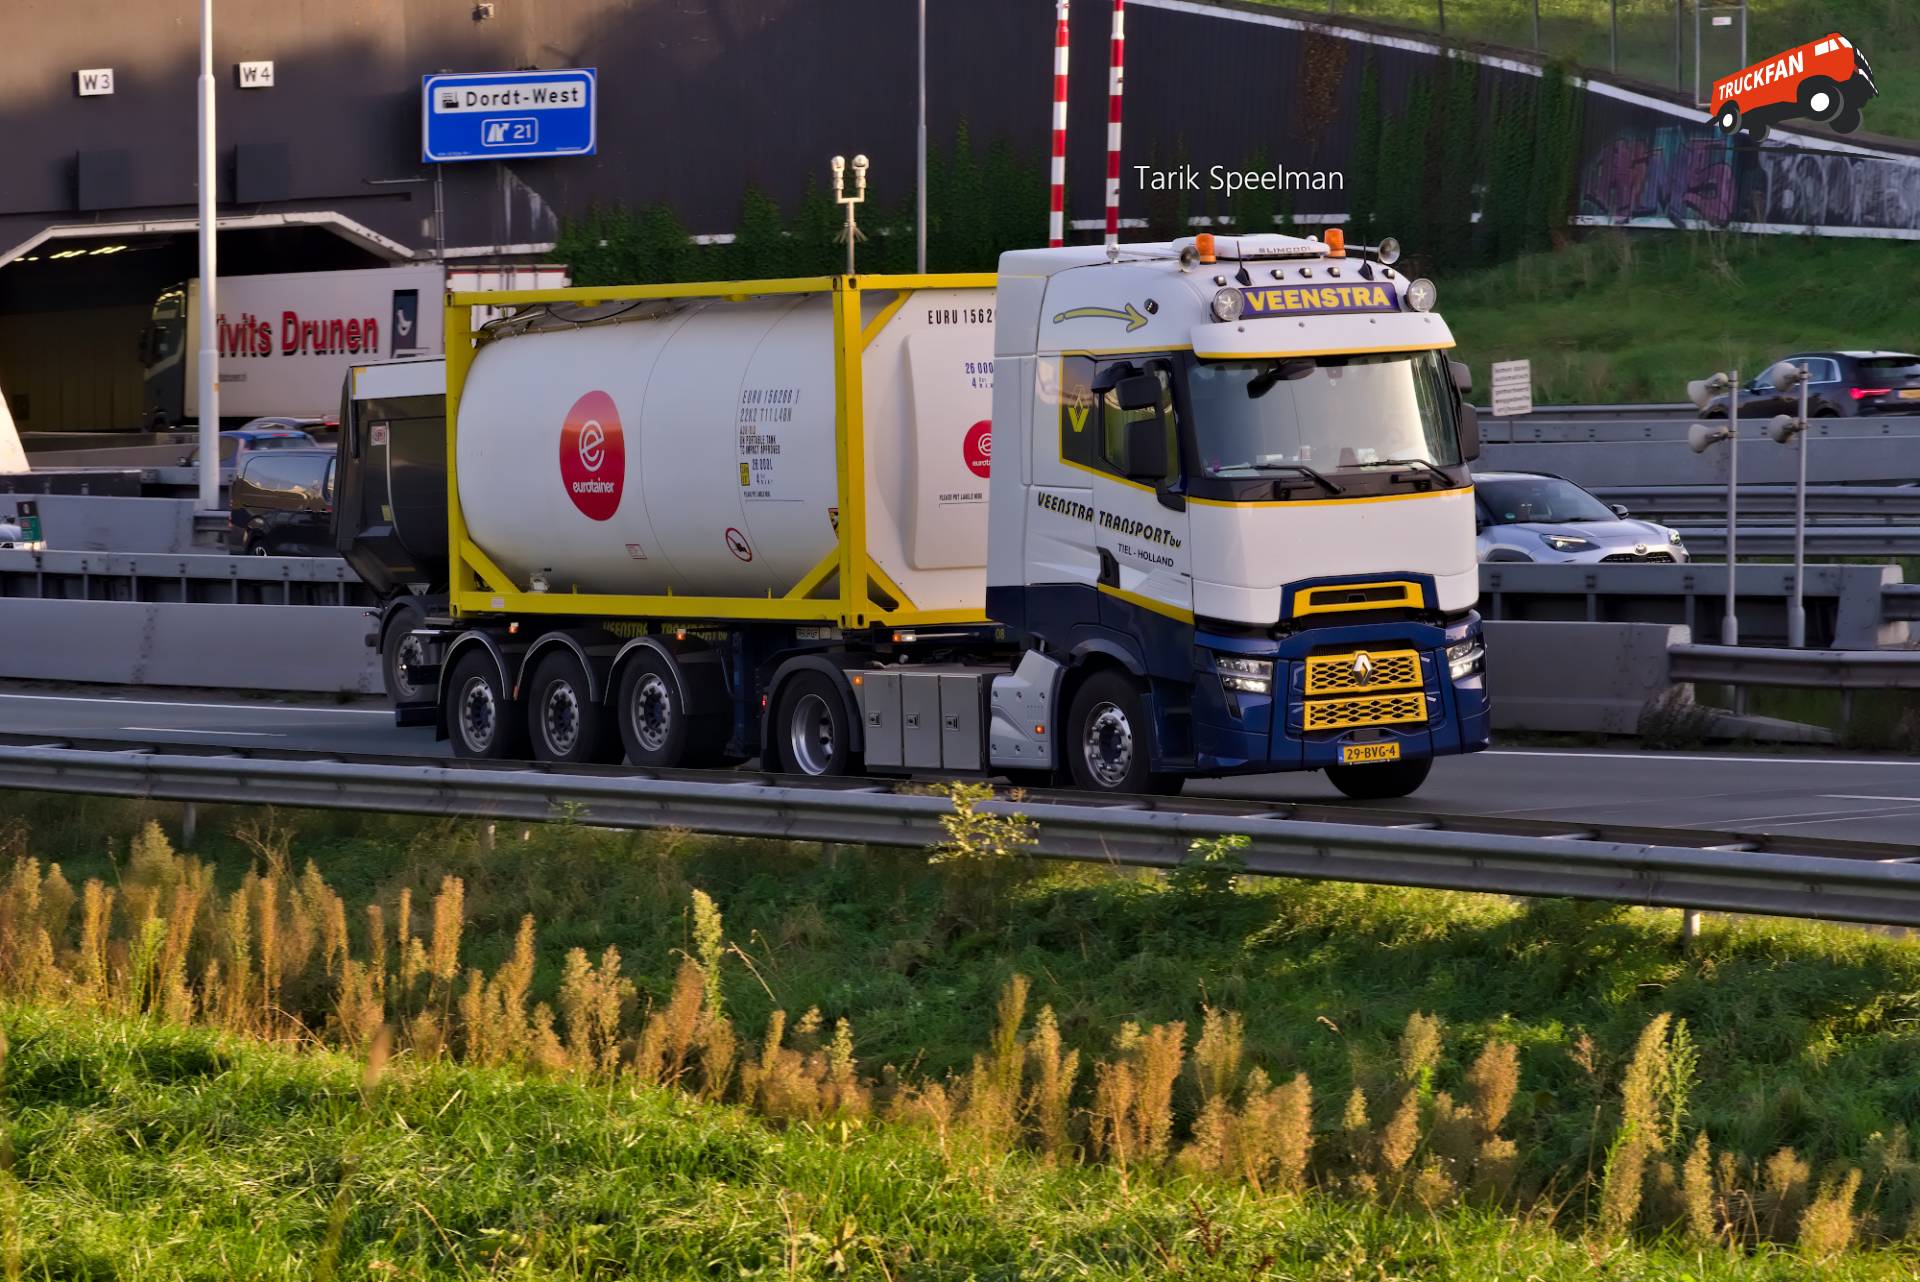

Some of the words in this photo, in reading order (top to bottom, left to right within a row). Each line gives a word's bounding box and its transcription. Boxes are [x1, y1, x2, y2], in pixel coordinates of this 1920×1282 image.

[466, 87, 579, 107] Dordt-West
[513, 124, 531, 139] 21
[1246, 286, 1391, 312] VEENSTRA
[928, 309, 958, 325] EURU
[963, 308, 997, 324] 1562
[216, 312, 273, 358] ivits
[281, 310, 379, 356] Drunen
[965, 362, 975, 374] 26
[977, 362, 994, 374] 000
[971, 377, 977, 389] 4
[572, 477, 615, 494] eurotainer
[1037, 491, 1095, 523] VEENSTRA
[1118, 543, 1132, 556] TIEL
[1137, 549, 1174, 568] HOLLAND
[1347, 745, 1396, 760] 29-BVG-4
